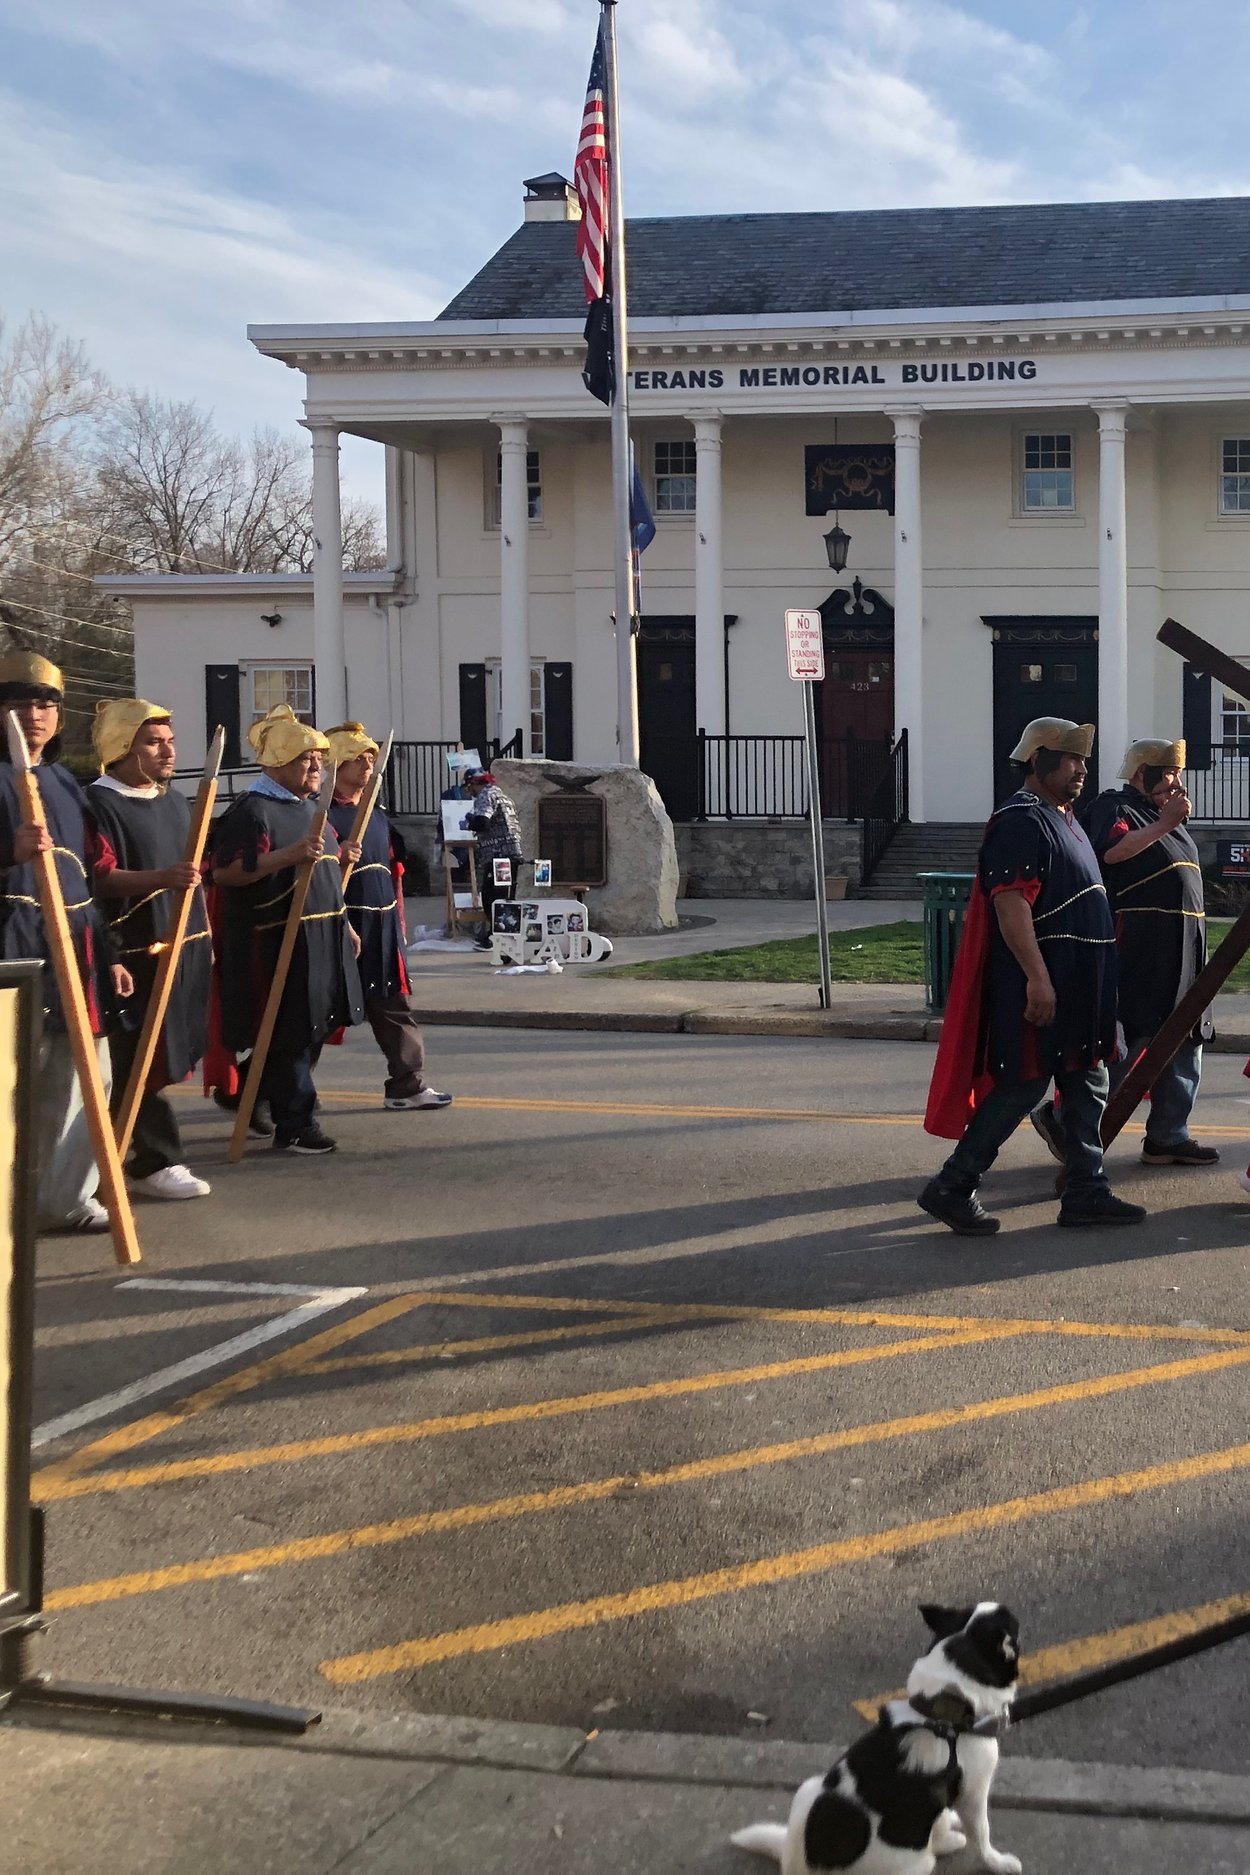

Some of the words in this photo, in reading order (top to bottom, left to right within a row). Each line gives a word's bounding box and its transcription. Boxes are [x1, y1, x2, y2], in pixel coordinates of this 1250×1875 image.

[581, 369, 724, 390] ERANS
[739, 365, 886, 388] MEMORIAL
[902, 360, 1038, 384] BUILDING
[797, 618, 810, 629] NO
[790, 630, 818, 639] STOPPING
[800, 640, 809, 648] OR
[791, 650, 820, 658] STANDING
[851, 682, 870, 691] 423
